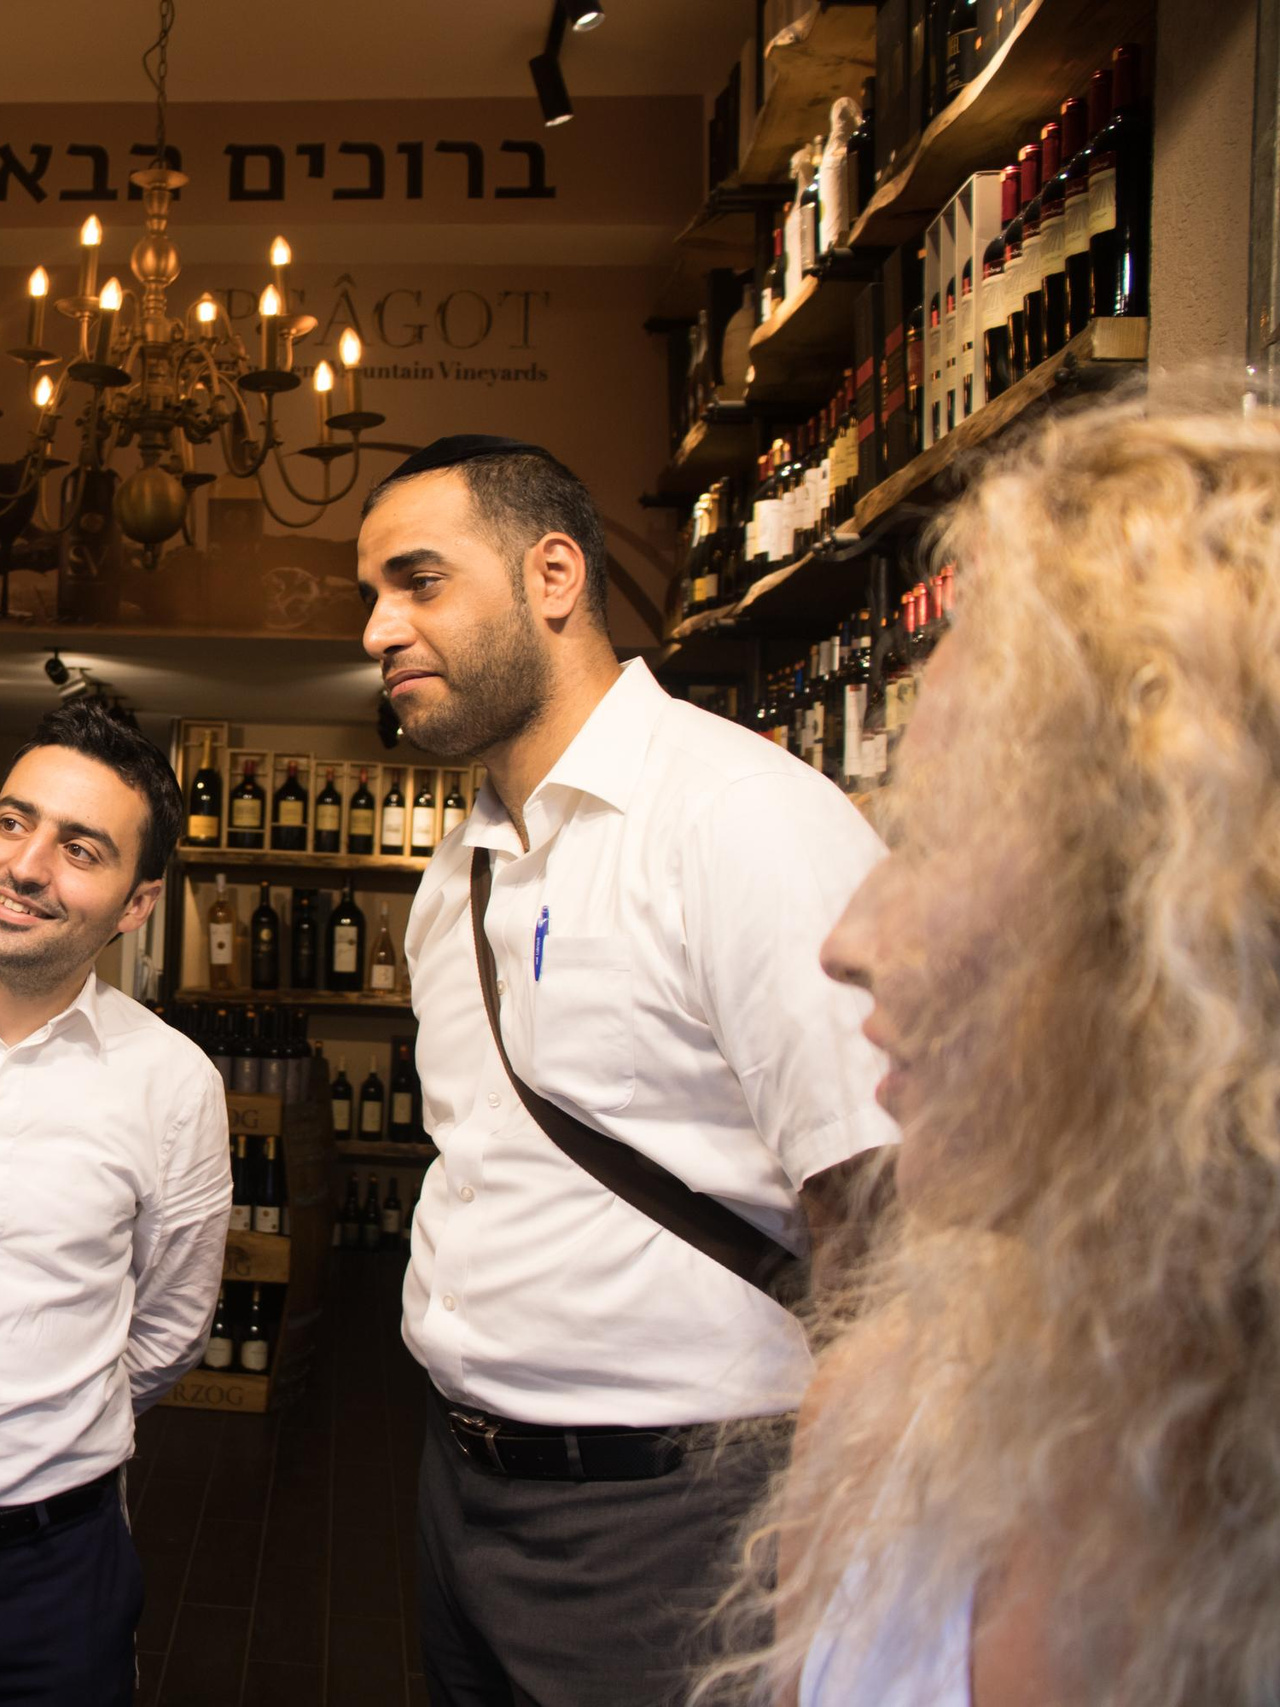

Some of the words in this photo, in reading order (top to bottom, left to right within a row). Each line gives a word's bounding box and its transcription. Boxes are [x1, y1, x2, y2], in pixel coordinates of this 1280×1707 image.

[224, 140, 556, 201] ברוכים
[438, 361, 549, 387] Vineyards
[164, 1383, 244, 1406] RZOG
